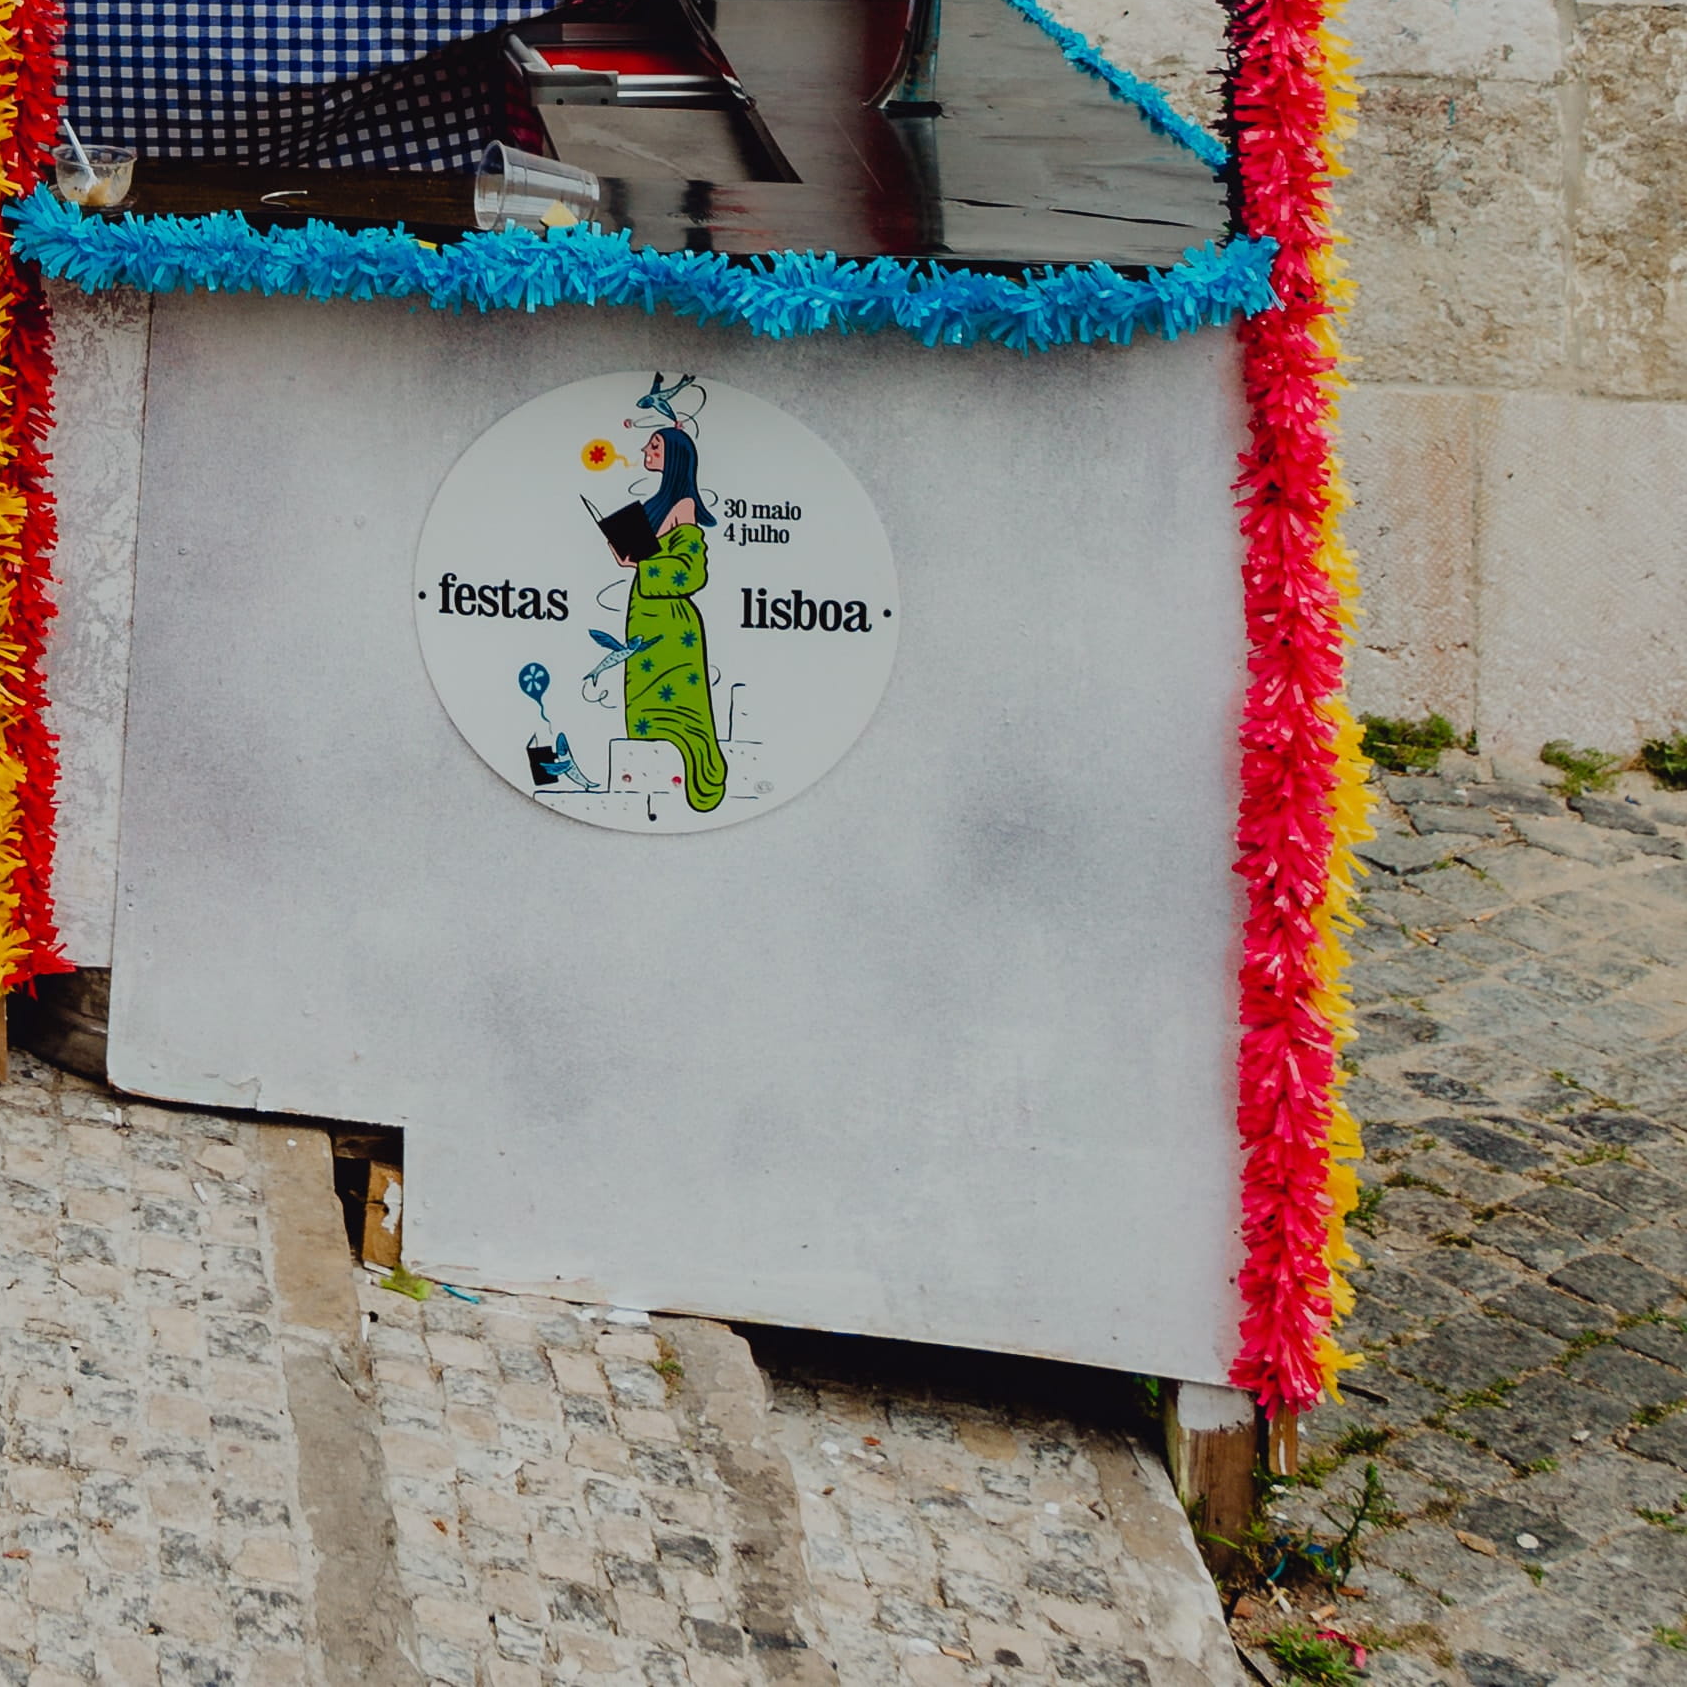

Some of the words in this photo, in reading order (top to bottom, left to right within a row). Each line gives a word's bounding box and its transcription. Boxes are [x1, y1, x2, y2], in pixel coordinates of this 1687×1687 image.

[723, 498, 749, 520] 30
[751, 500, 802, 521] maio
[723, 523, 736, 543] 4
[738, 524, 790, 547] julho
[438, 573, 570, 622] festas
[739, 588, 873, 634] lisboa
